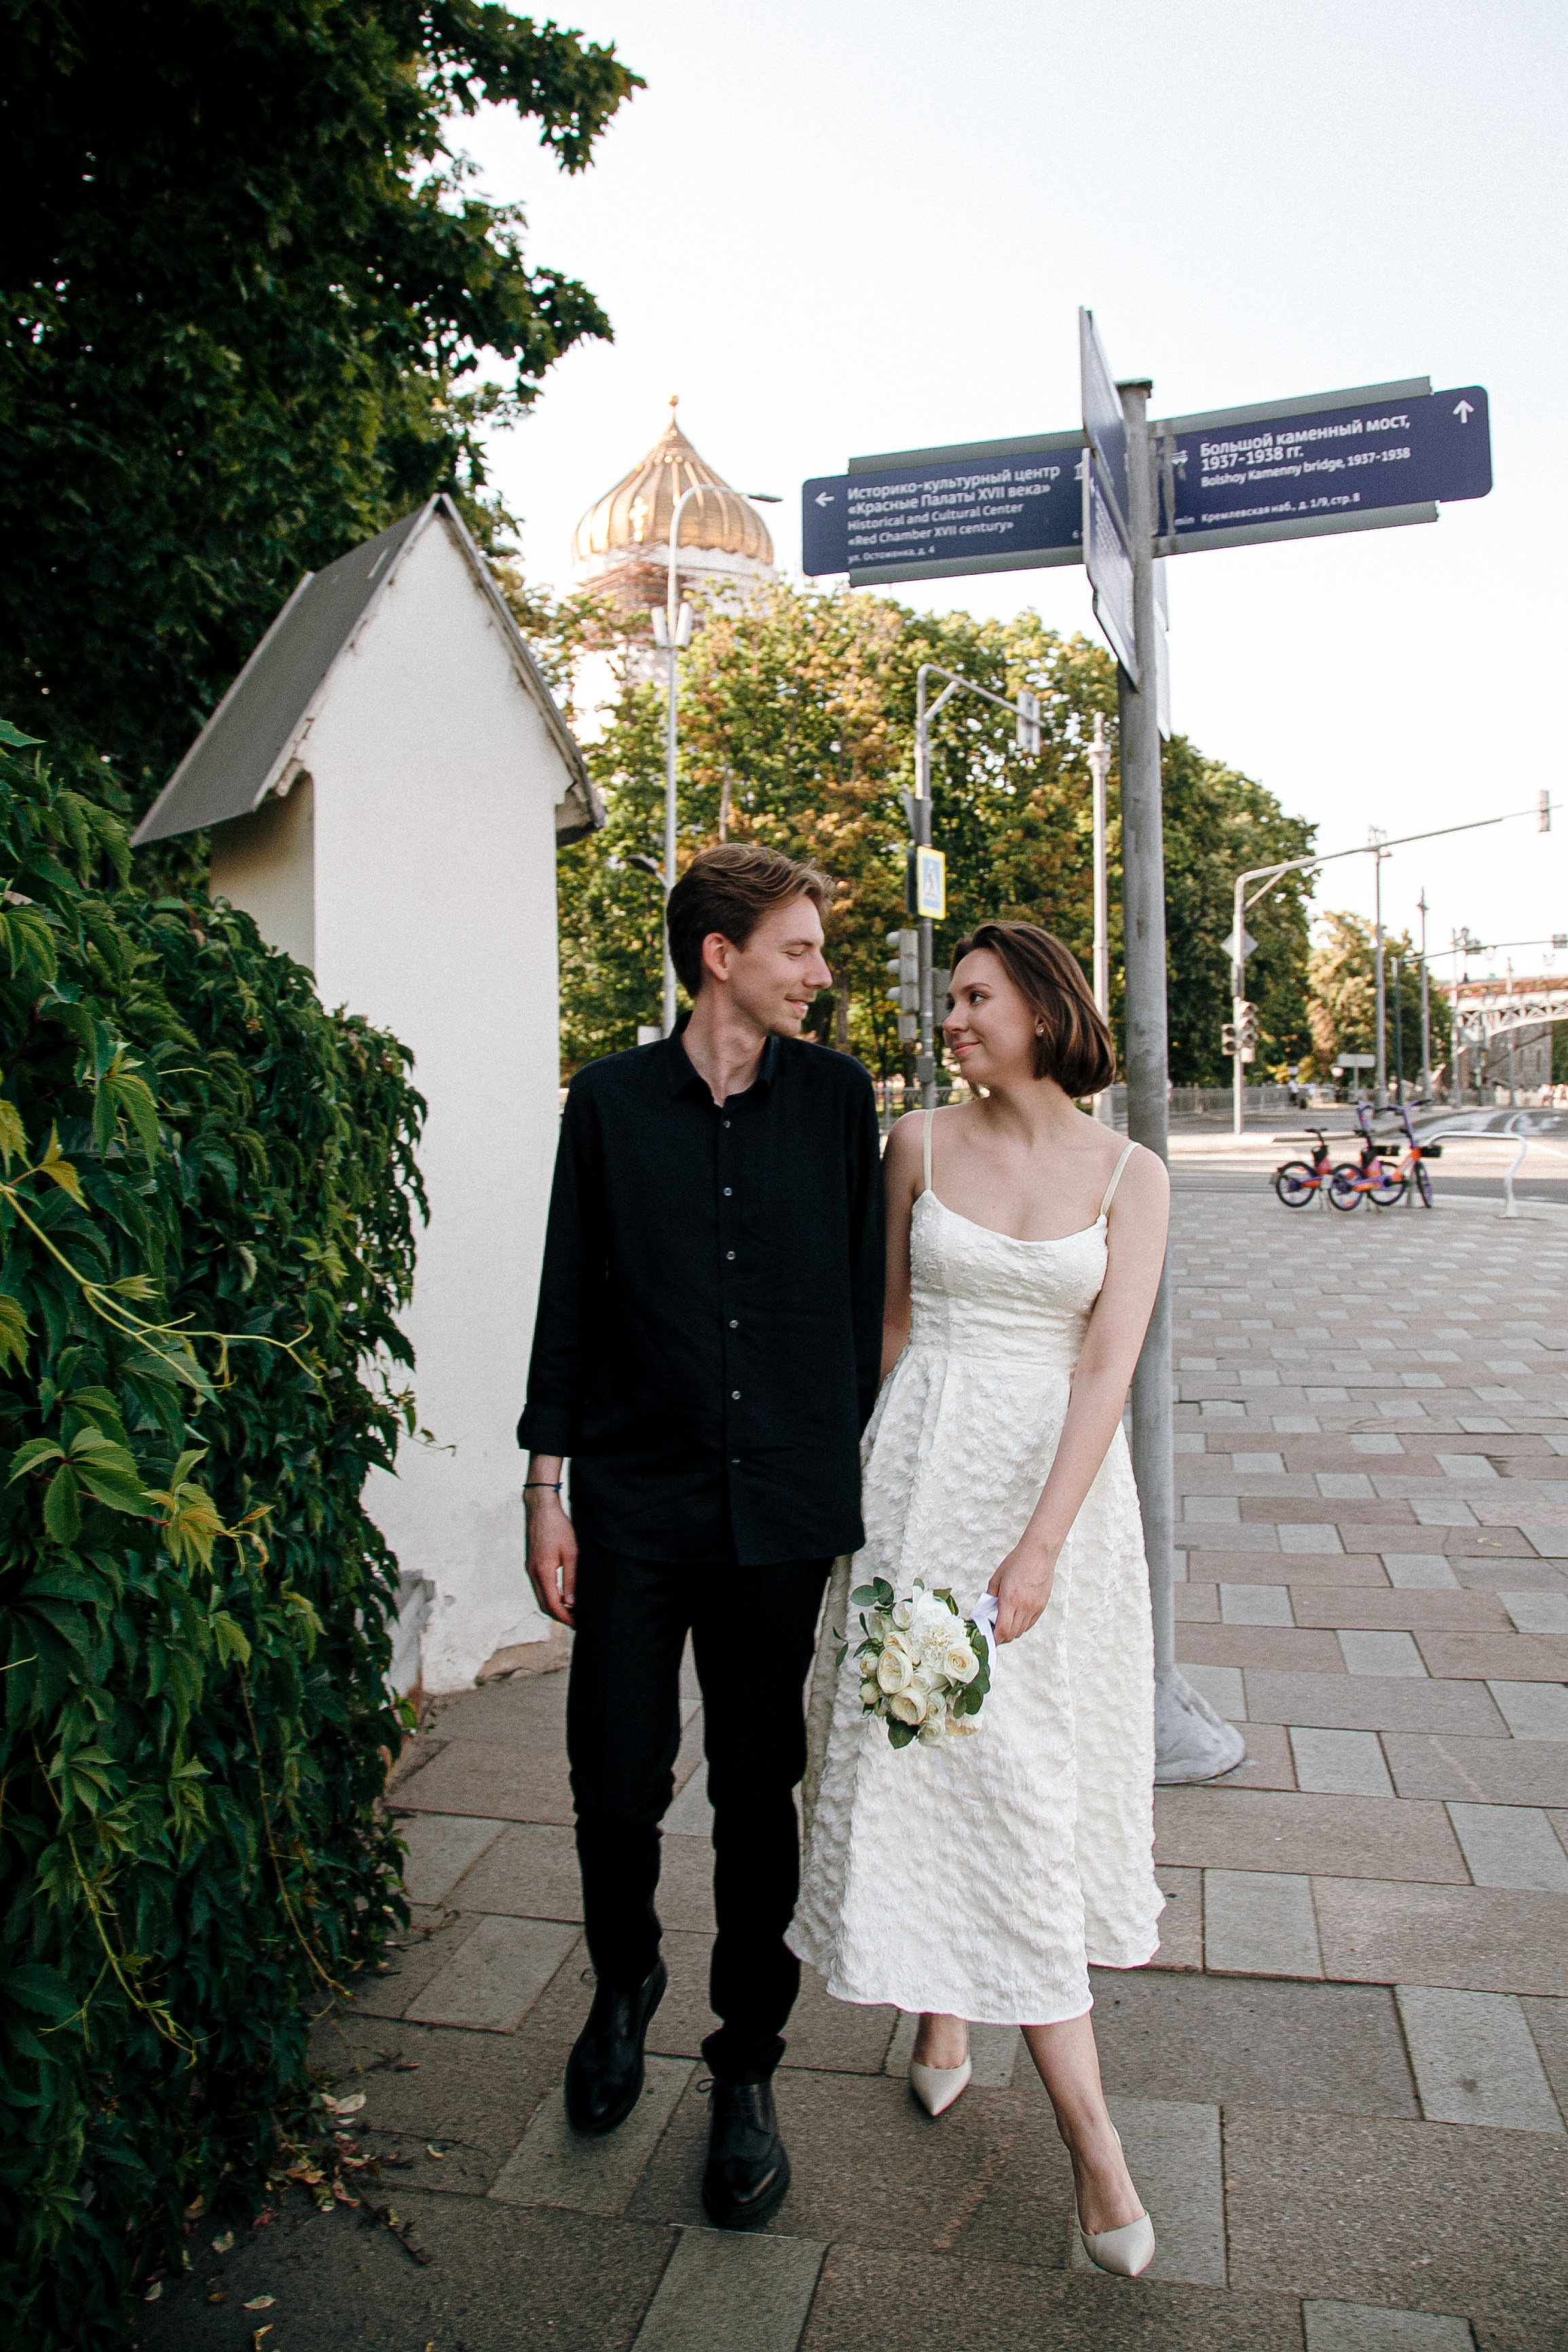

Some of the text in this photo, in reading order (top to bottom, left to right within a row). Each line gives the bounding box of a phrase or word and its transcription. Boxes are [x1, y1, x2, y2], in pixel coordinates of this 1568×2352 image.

[1200, 414, 1411, 458] Большой каменный мост,
[1201, 446, 1284, 472] 1937-1938
[1201, 447, 1411, 487] Bolshoy Kamenny bridge, 1937-1938
[1014, 466, 1061, 483] центр
[848, 483, 1051, 517] «Красные Палаты XVII века»
[847, 504, 1024, 531] Historical and Cultural Center
[878, 528, 933, 544] Chamber
[958, 521, 1014, 536] century»
[928, 544, 935, 554] 4
